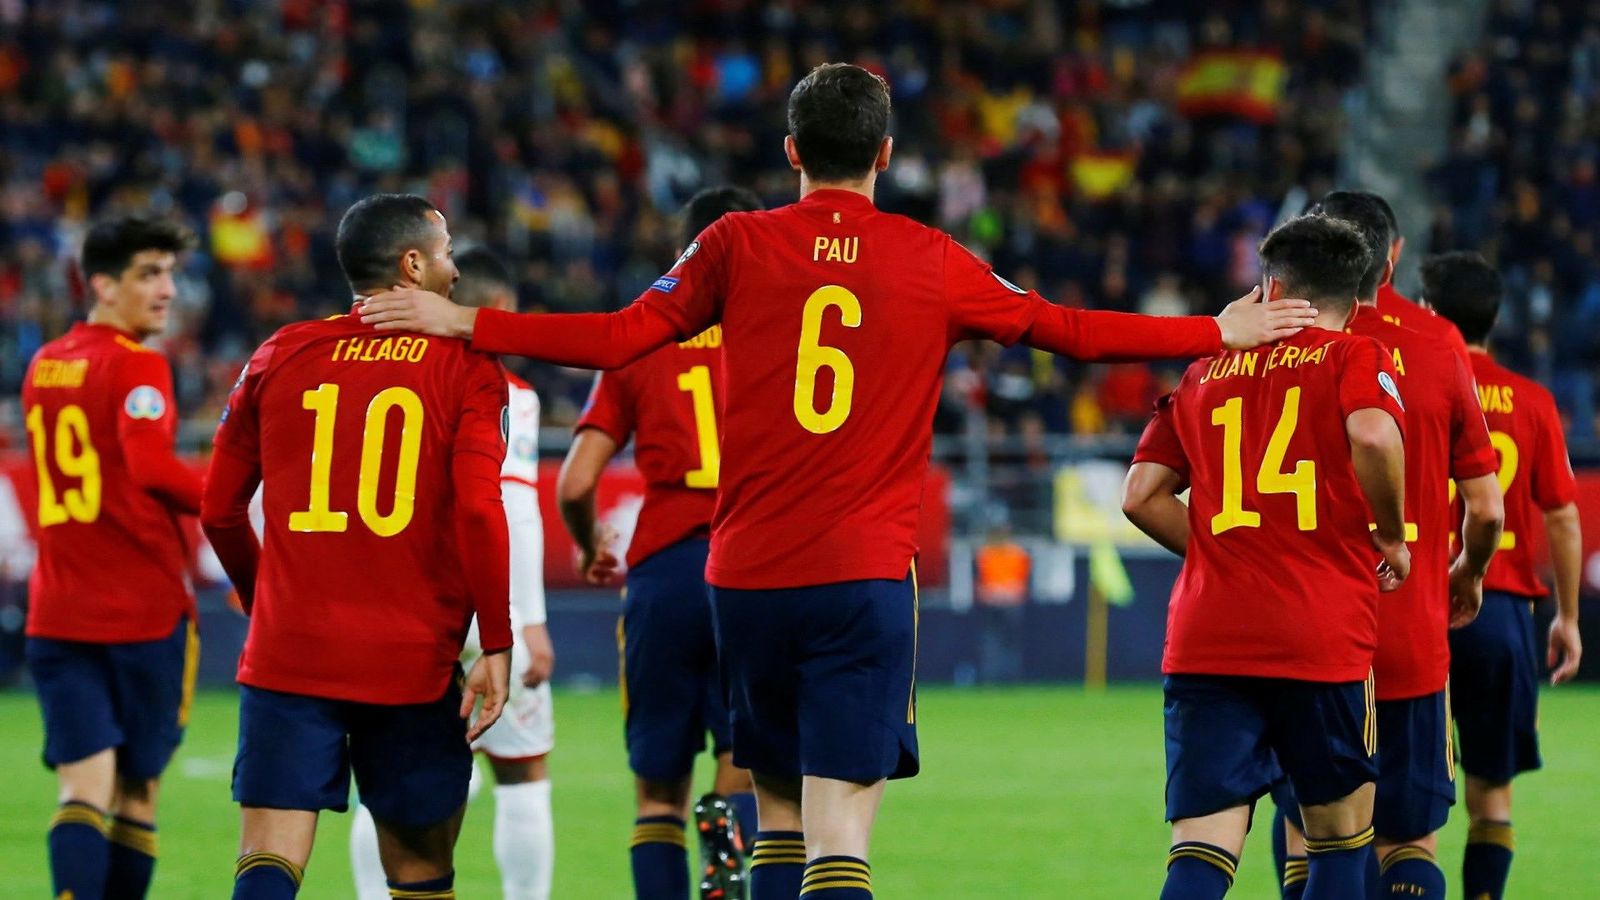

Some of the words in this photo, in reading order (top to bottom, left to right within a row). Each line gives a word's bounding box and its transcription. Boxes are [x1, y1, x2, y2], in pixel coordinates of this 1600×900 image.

[814, 237, 858, 263] PAU
[332, 337, 429, 363] THIAGO
[794, 285, 861, 434] 6
[1200, 349, 1259, 384] JUAN
[1262, 341, 1335, 378] ERNAT
[27, 405, 101, 526] 19
[289, 384, 424, 536] 10
[1211, 387, 1317, 535] 14
